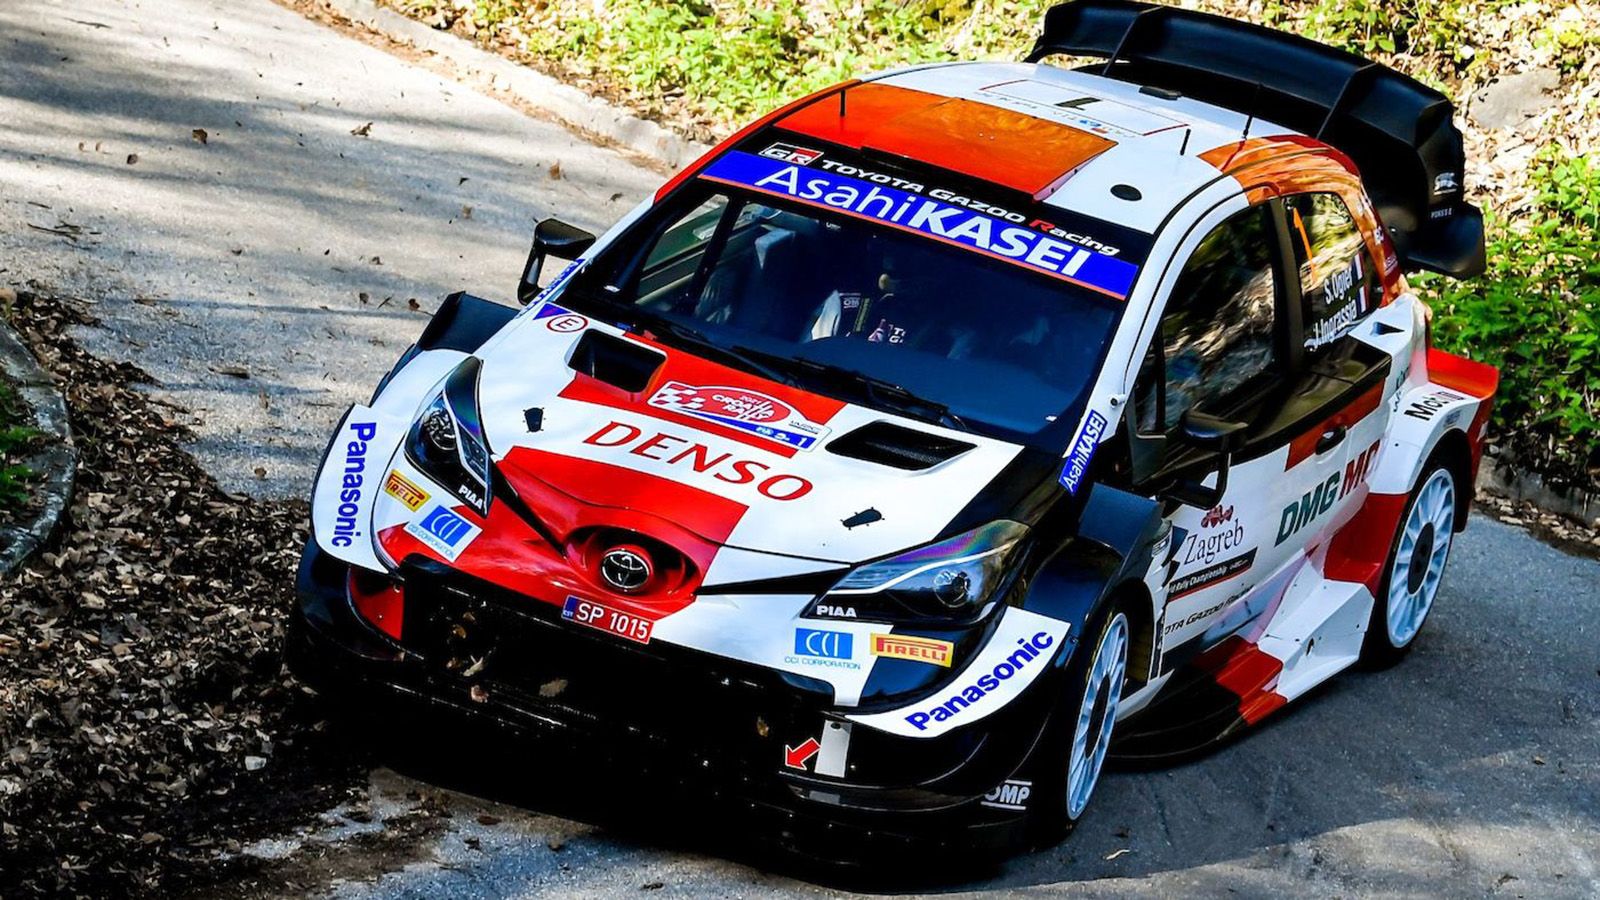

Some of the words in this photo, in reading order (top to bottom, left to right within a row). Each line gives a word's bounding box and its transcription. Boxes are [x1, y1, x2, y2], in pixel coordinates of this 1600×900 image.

[762, 146, 814, 165] GR
[754, 166, 1091, 277] AsahiKASEI
[822, 159, 924, 192] TOYOTA
[928, 188, 1026, 224] GAZOO
[1028, 219, 1121, 257] Racing
[582, 421, 813, 501] DENSO
[1063, 413, 1105, 492] AsahiKASEI
[331, 422, 377, 547] Panasonic
[386, 473, 426, 507] PIRELLI
[458, 485, 483, 509] PIAA
[1184, 518, 1244, 564] Zagreb
[576, 603, 604, 623] SP
[610, 612, 649, 639] 1015
[816, 605, 857, 618] PIAA
[806, 632, 839, 656] CCI
[876, 637, 948, 661] PIRELLI
[801, 657, 861, 670] CORPORATION
[905, 632, 1053, 730] Panasonic
